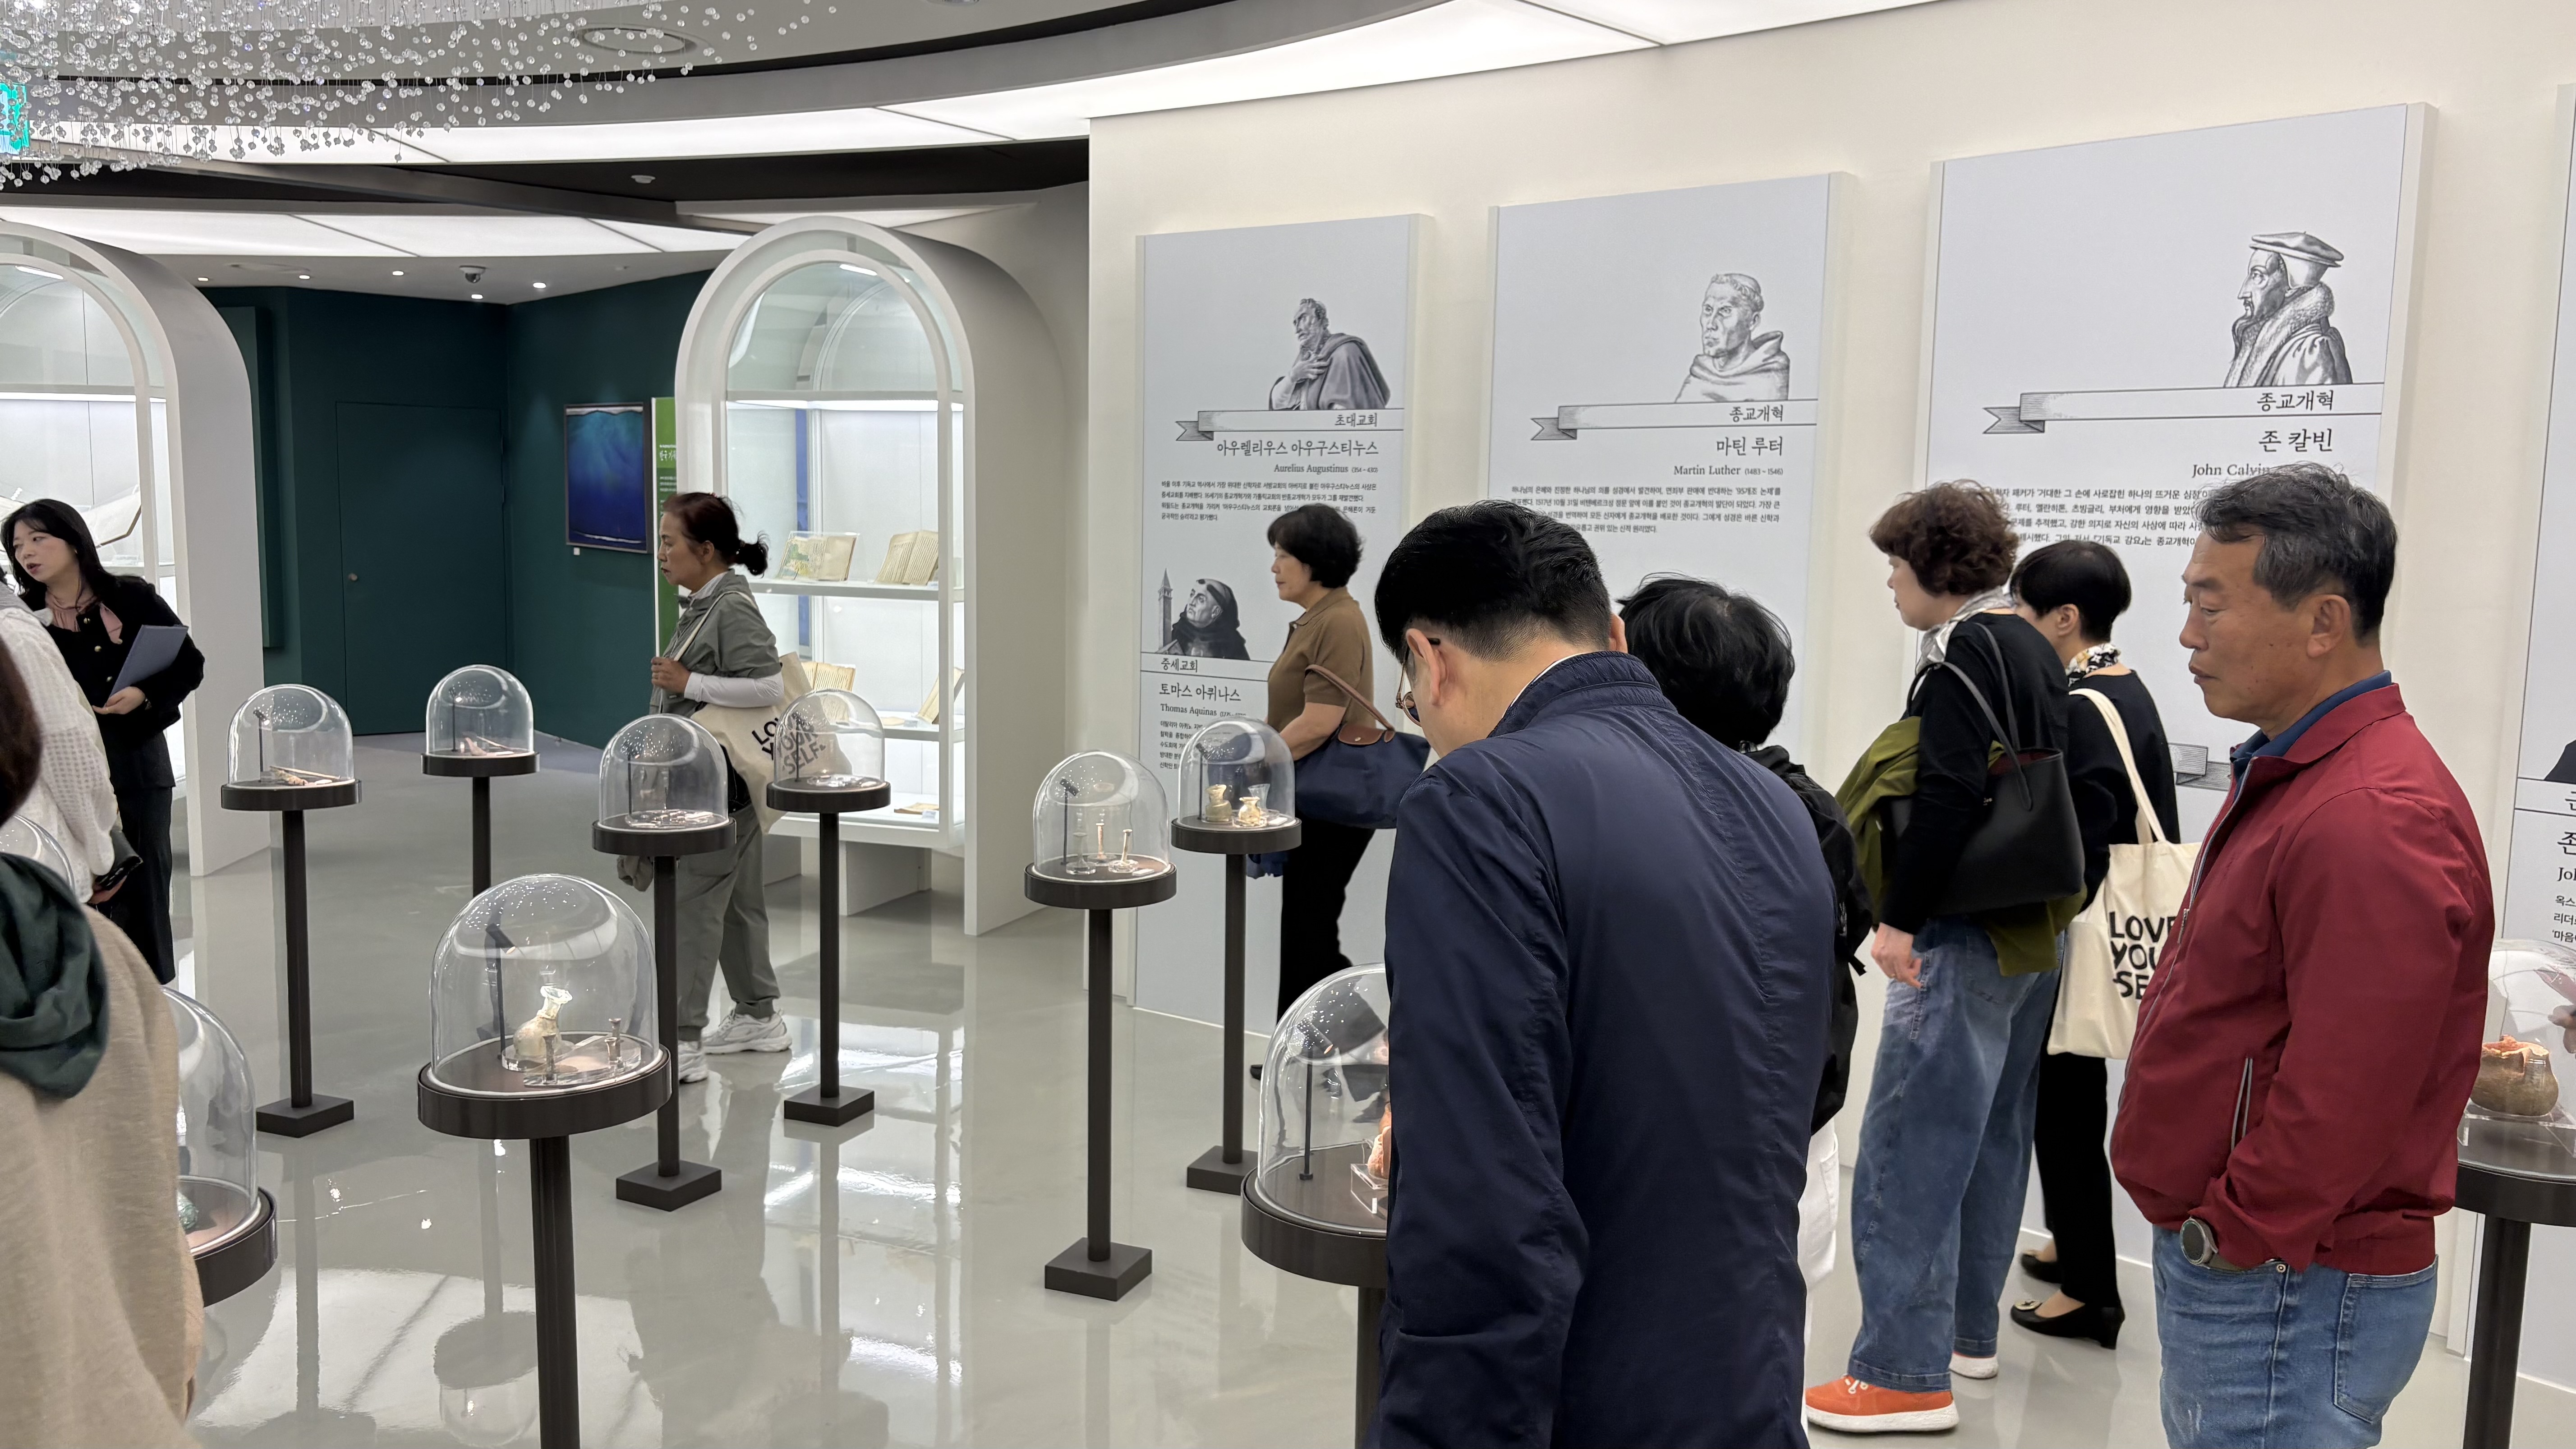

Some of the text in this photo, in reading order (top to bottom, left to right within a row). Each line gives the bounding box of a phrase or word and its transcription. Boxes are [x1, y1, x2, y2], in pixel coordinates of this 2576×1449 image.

[2257, 389, 2334, 412] 종교개혁
[1334, 412, 1377, 428] 초대교회
[1729, 404, 1784, 423] 종교개혁
[1716, 436, 1783, 456] 마틴 루터
[2258, 428, 2332, 452] 존 칼빈
[1217, 439, 1379, 457] 아우렐리우스 아우구스티누스
[1274, 463, 1305, 473] Aurelius
[1306, 464, 1349, 475] Augustinus
[1674, 464, 1705, 475] Martin
[1709, 465, 1741, 475] Luther
[2191, 463, 2222, 478] John
[1511, 486, 1534, 494] 하나님의
[1535, 486, 1552, 494] 은혜와
[1573, 486, 1596, 495] 하나님의
[1612, 486, 1636, 495] 성경에서
[1707, 487, 1733, 496] 반대하는
[2012, 488, 2035, 498] 패커가
[2064, 489, 2072, 497] 그
[2075, 489, 2091, 498] 손에
[2093, 489, 2125, 499] 사로잡힌
[2128, 489, 2153, 499] 하나의
[2155, 489, 2180, 500] 뜨거운
[1553, 498, 1566, 507] 10월
[1566, 498, 1578, 507] 31일
[1670, 499, 1682, 508] 것이
[1683, 499, 1714, 509] 종교개혁의
[1758, 501, 1772, 509] 가장
[2109, 505, 2141, 515] 부처에게
[2145, 505, 2169, 515] 영향을
[2174, 506, 2192, 515] 받았
[1603, 511, 1627, 520] 신자에게
[1606, 524, 1618, 533] 있는
[2070, 519, 2086, 529] 강한
[2088, 519, 2111, 529] 의지로
[2114, 520, 2139, 530] 자신의
[2141, 520, 2167, 531] 사상에
[2169, 521, 2186, 531] 따라
[1161, 658, 1198, 673] 중세교회
[1159, 682, 1242, 703] 토마스 아퀴나스
[1160, 703, 1187, 713] Thomas
[1189, 706, 1217, 717] Aquinas
[2552, 929, 2576, 943] '마음
[2112, 971, 2149, 1000] SE
